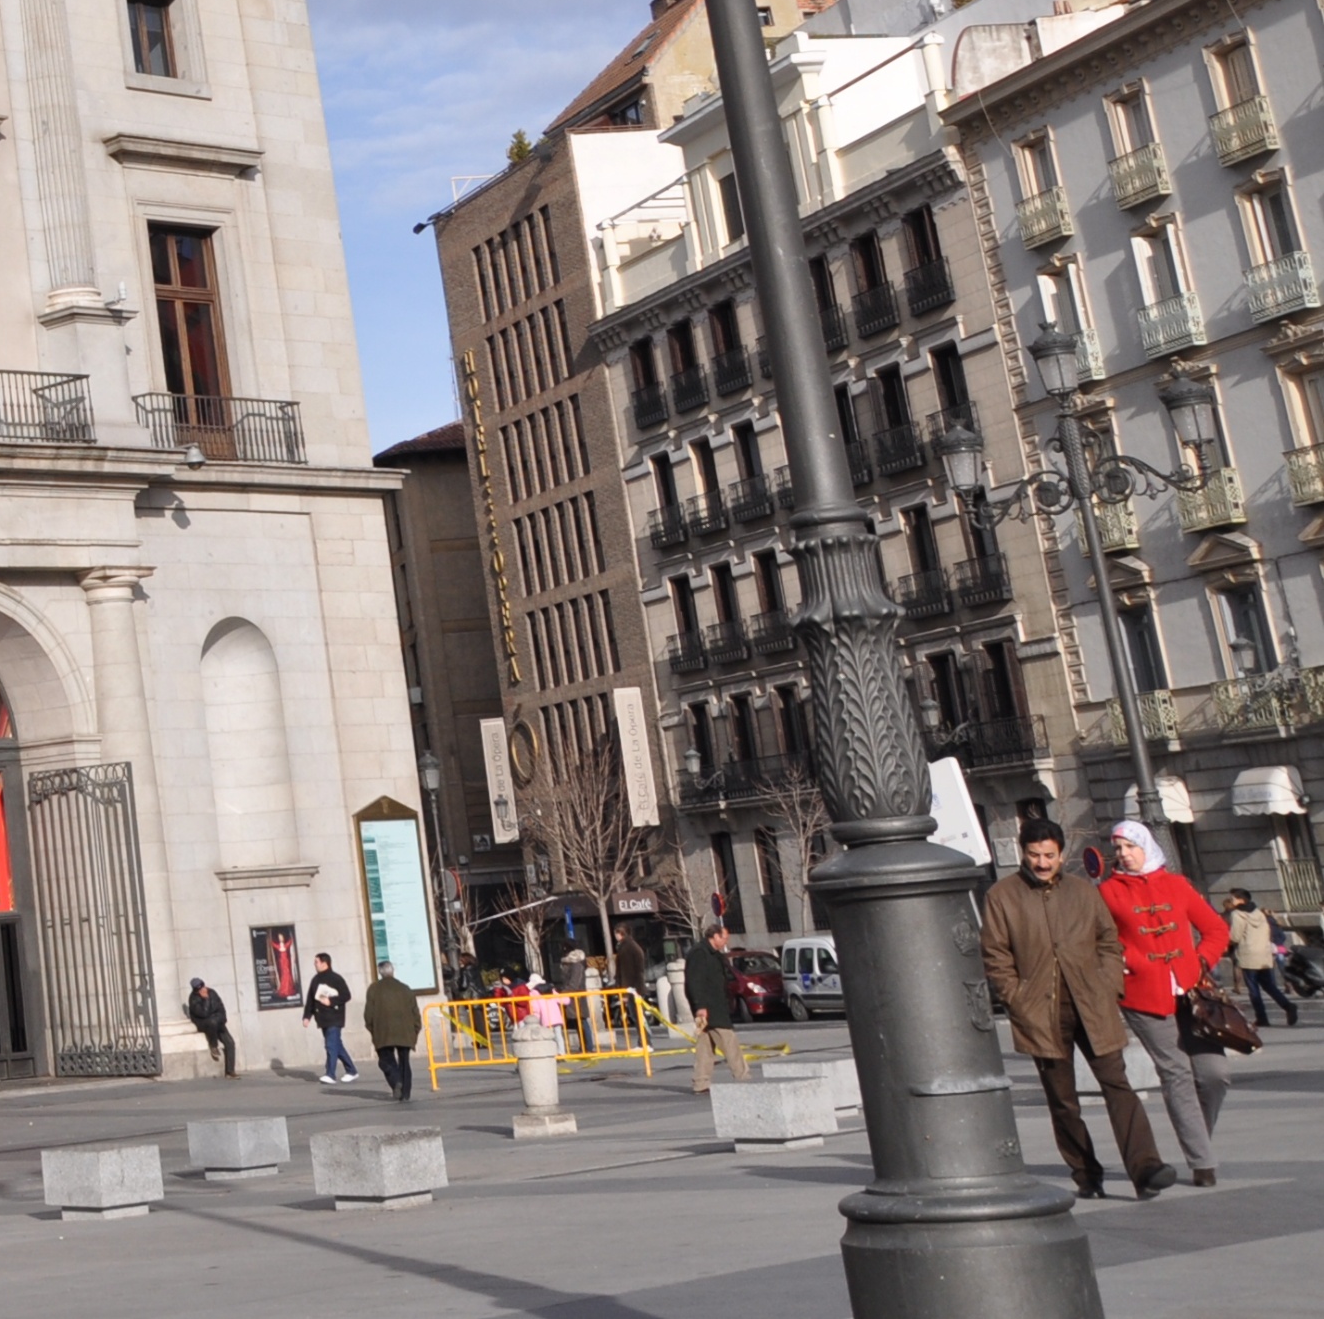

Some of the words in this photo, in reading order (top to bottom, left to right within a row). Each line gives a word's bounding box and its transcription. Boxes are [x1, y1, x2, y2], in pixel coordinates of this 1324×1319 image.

[463, 347, 491, 478] HOTEL
[632, 739, 641, 754] La
[497, 763, 505, 777] La
[634, 756, 644, 770] de
[618, 900, 628, 910] El
[630, 898, 652, 910] Café
